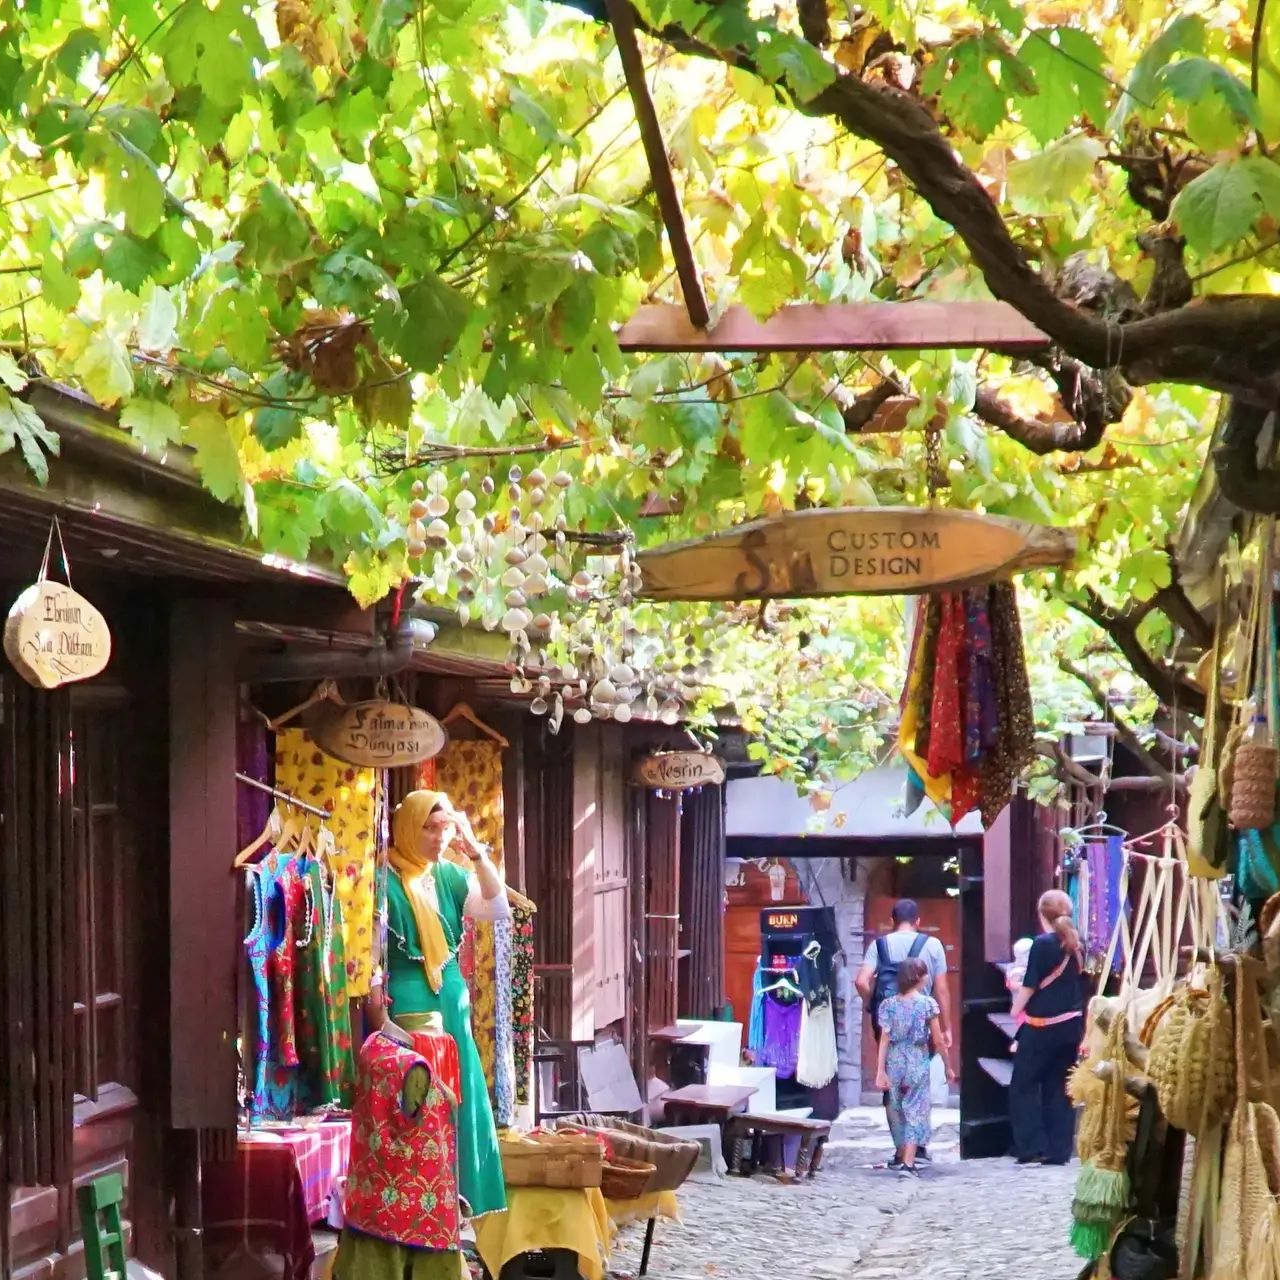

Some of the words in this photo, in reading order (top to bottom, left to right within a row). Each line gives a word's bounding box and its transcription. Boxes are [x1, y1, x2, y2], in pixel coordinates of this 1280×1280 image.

[826, 529, 941, 551] CUSTOM
[829, 555, 922, 578] DESIGN
[767, 914, 799, 926] BURN
